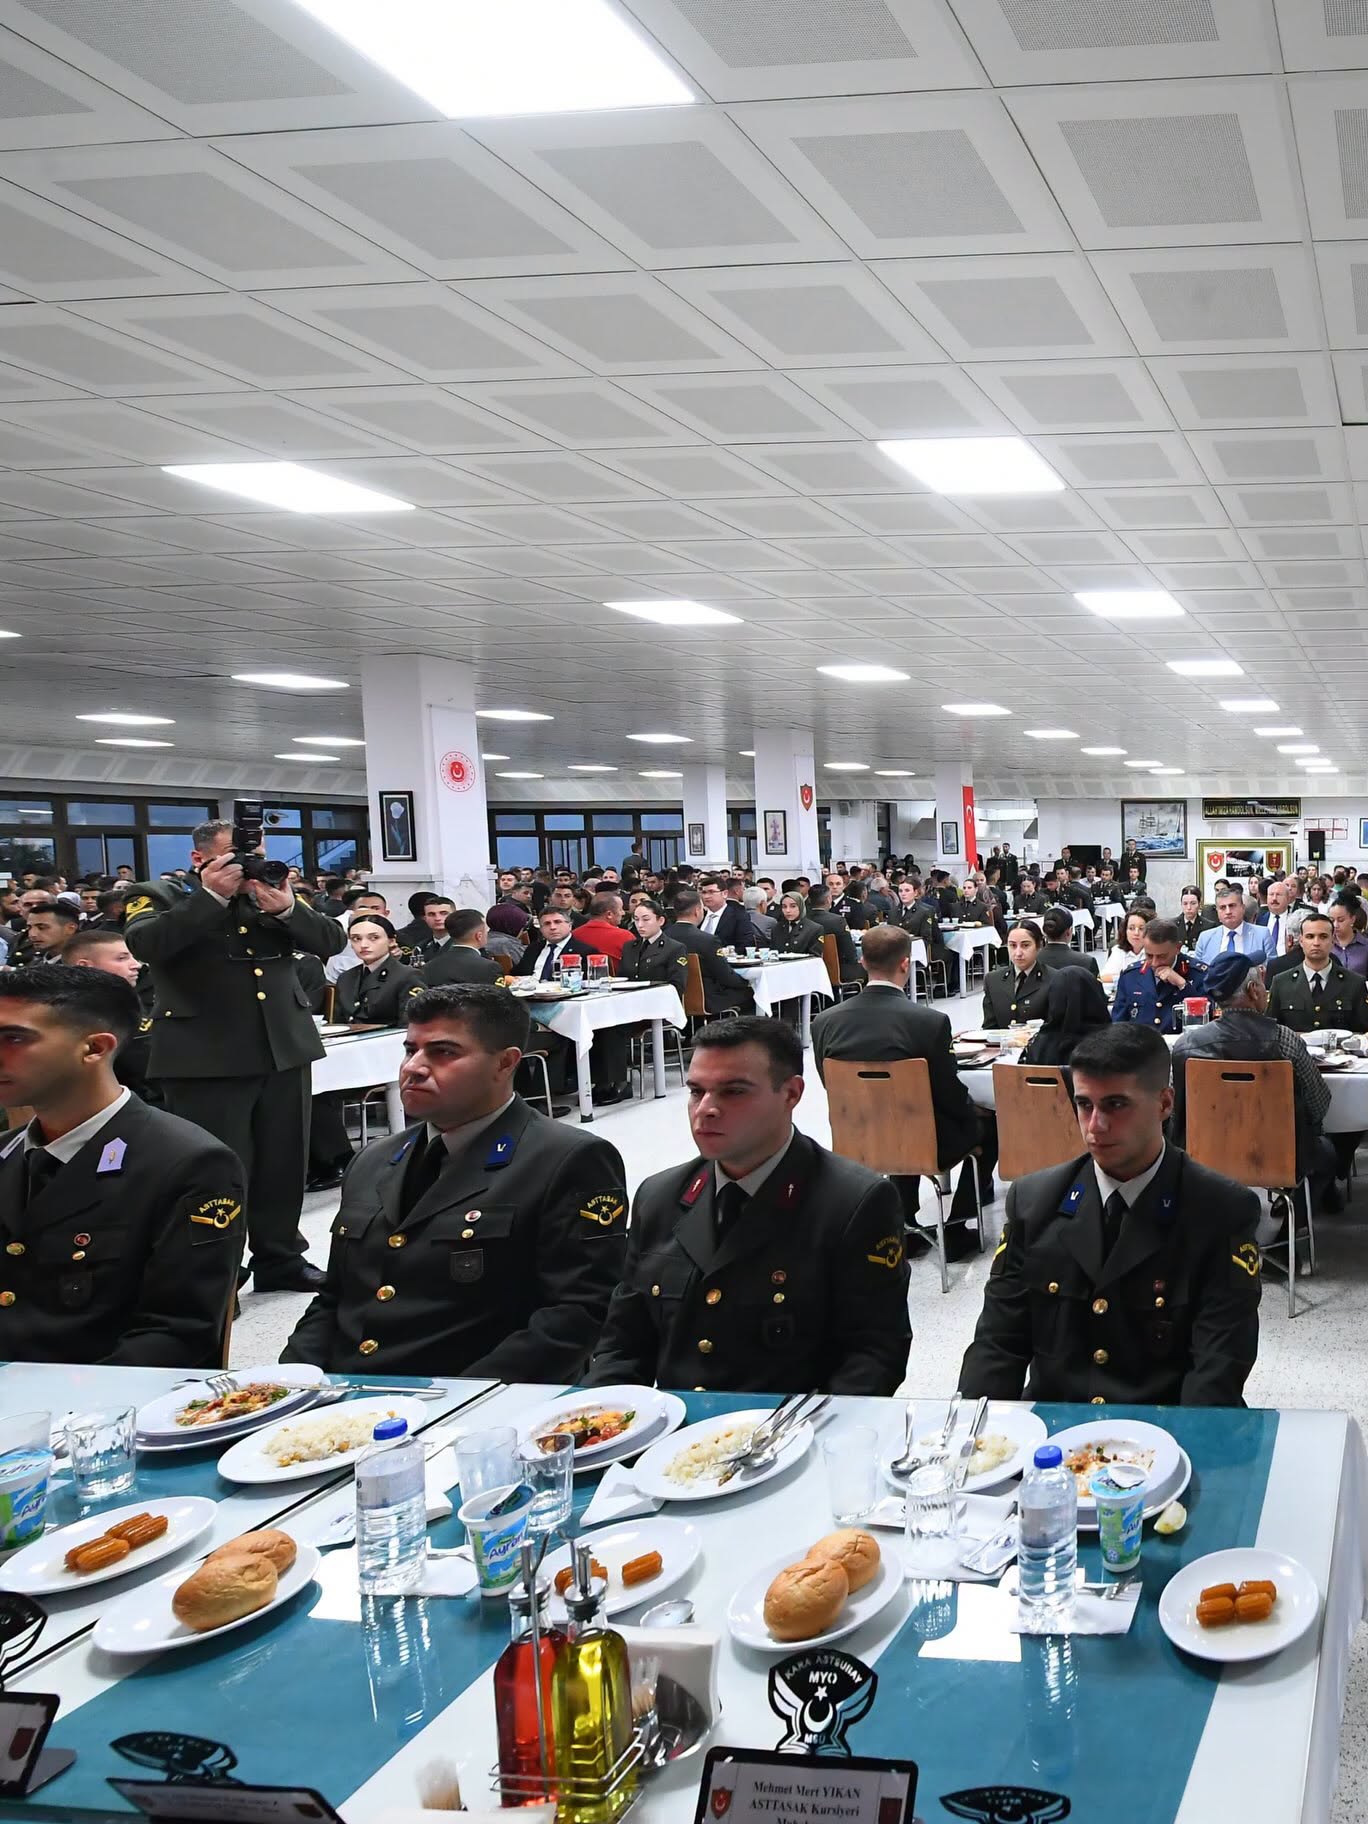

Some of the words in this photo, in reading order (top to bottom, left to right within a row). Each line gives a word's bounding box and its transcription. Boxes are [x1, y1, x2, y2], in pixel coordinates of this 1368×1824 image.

[808, 1670, 838, 1684] MYO
[753, 1781, 793, 1794] Mehmet
[796, 1784, 820, 1797] Mert
[822, 1785, 861, 1799] YIKAN
[750, 1799, 808, 1814] ASTTASAK
[811, 1801, 860, 1817] Kursiyeri
